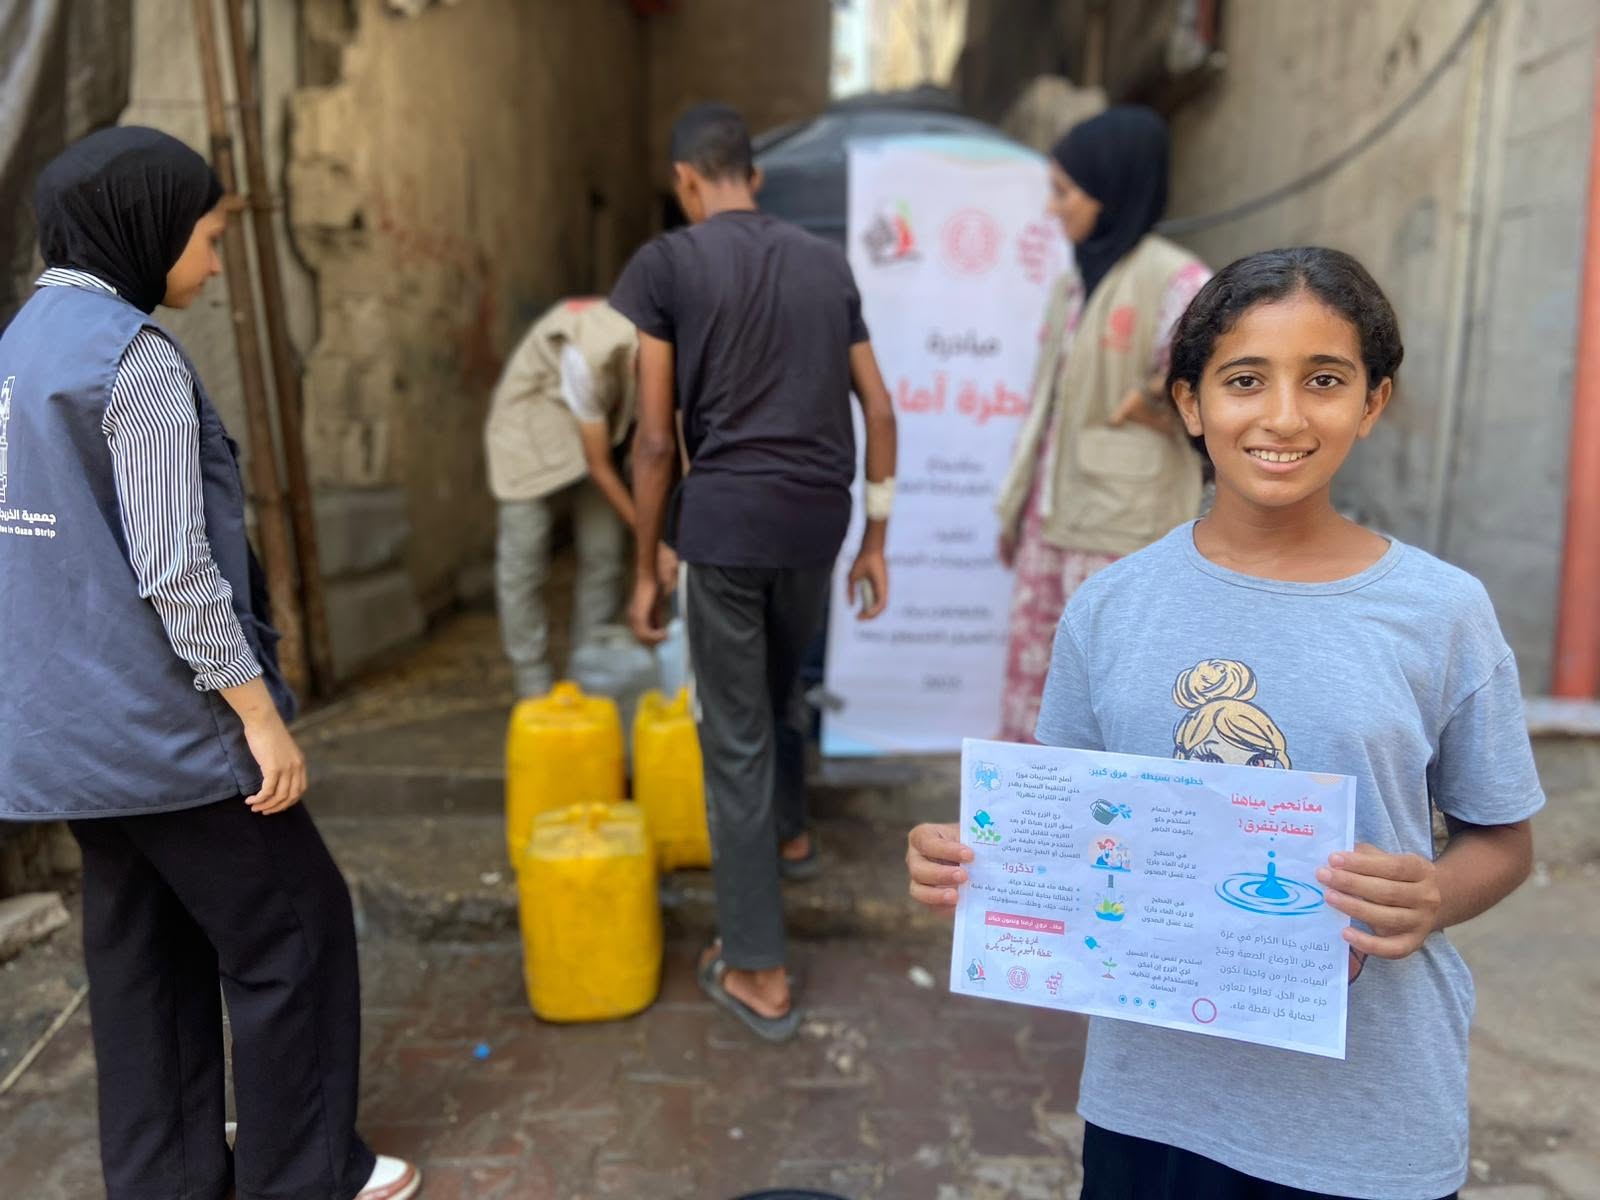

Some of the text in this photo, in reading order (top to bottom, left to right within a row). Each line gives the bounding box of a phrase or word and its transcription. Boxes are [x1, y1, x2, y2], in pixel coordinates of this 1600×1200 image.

[22, 510, 56, 524] جمعية
[15, 526, 33, 536] Gaza
[35, 527, 56, 539] Strip
[1110, 770, 1127, 779] فرق
[1140, 773, 1169, 782] بسيطة
[1173, 776, 1203, 785] خطوات
[1232, 793, 1265, 809] مياهنا
[1267, 799, 1300, 815] نحمي
[1244, 818, 1278, 835] بتفرق
[1281, 821, 1313, 836] نقطة
[1220, 930, 1234, 939] غزة
[1237, 934, 1250, 944] في
[1254, 935, 1278, 944] الكرام
[1238, 949, 1264, 960] الصعبة
[1268, 952, 1297, 967] الأوضاع
[1301, 959, 1315, 968] ظل
[1318, 963, 1333, 971] في
[1268, 973, 1280, 981] من
[1248, 985, 1272, 997] تعالوا
[1298, 995, 1310, 1003] من
[1248, 1003, 1270, 1014] نقطة
[1273, 1008, 1285, 1017] كل
[1288, 1010, 1314, 1022] لحماية
